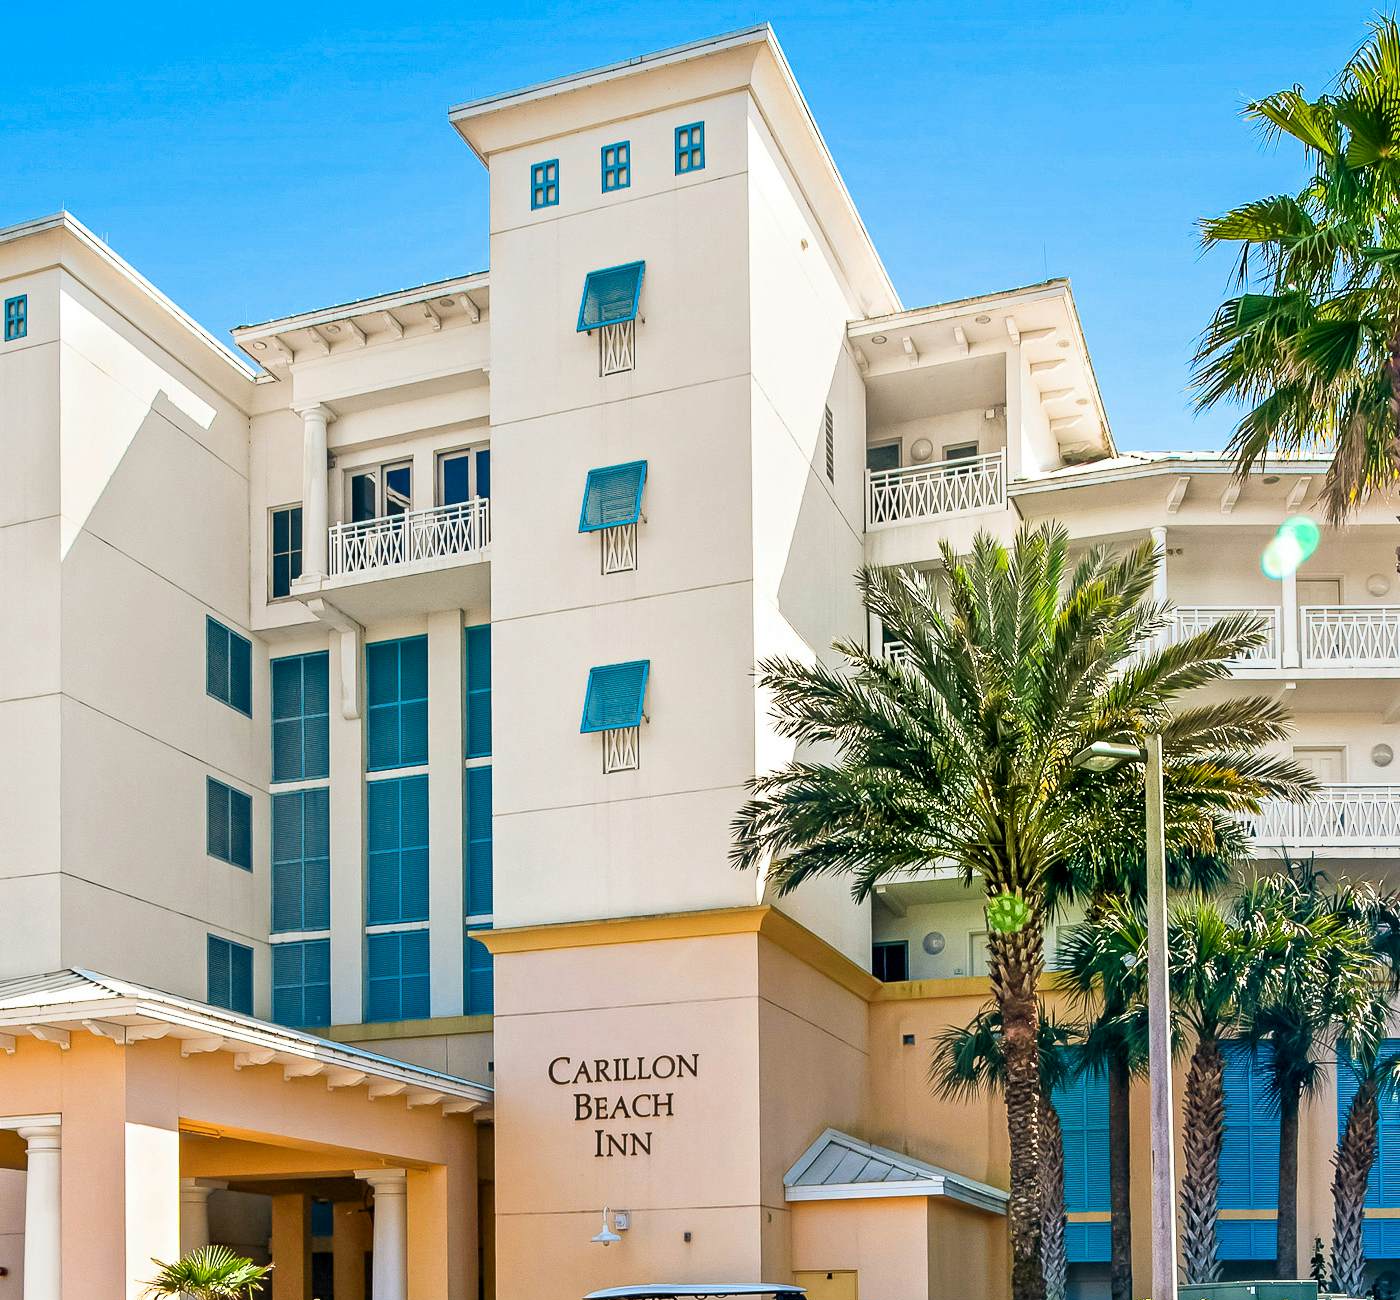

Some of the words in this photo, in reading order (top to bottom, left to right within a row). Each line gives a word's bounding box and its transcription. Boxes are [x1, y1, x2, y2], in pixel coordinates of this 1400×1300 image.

[548, 1053, 699, 1085] CARILLON
[574, 1093, 674, 1121] BEACH
[594, 1129, 652, 1157] INN
